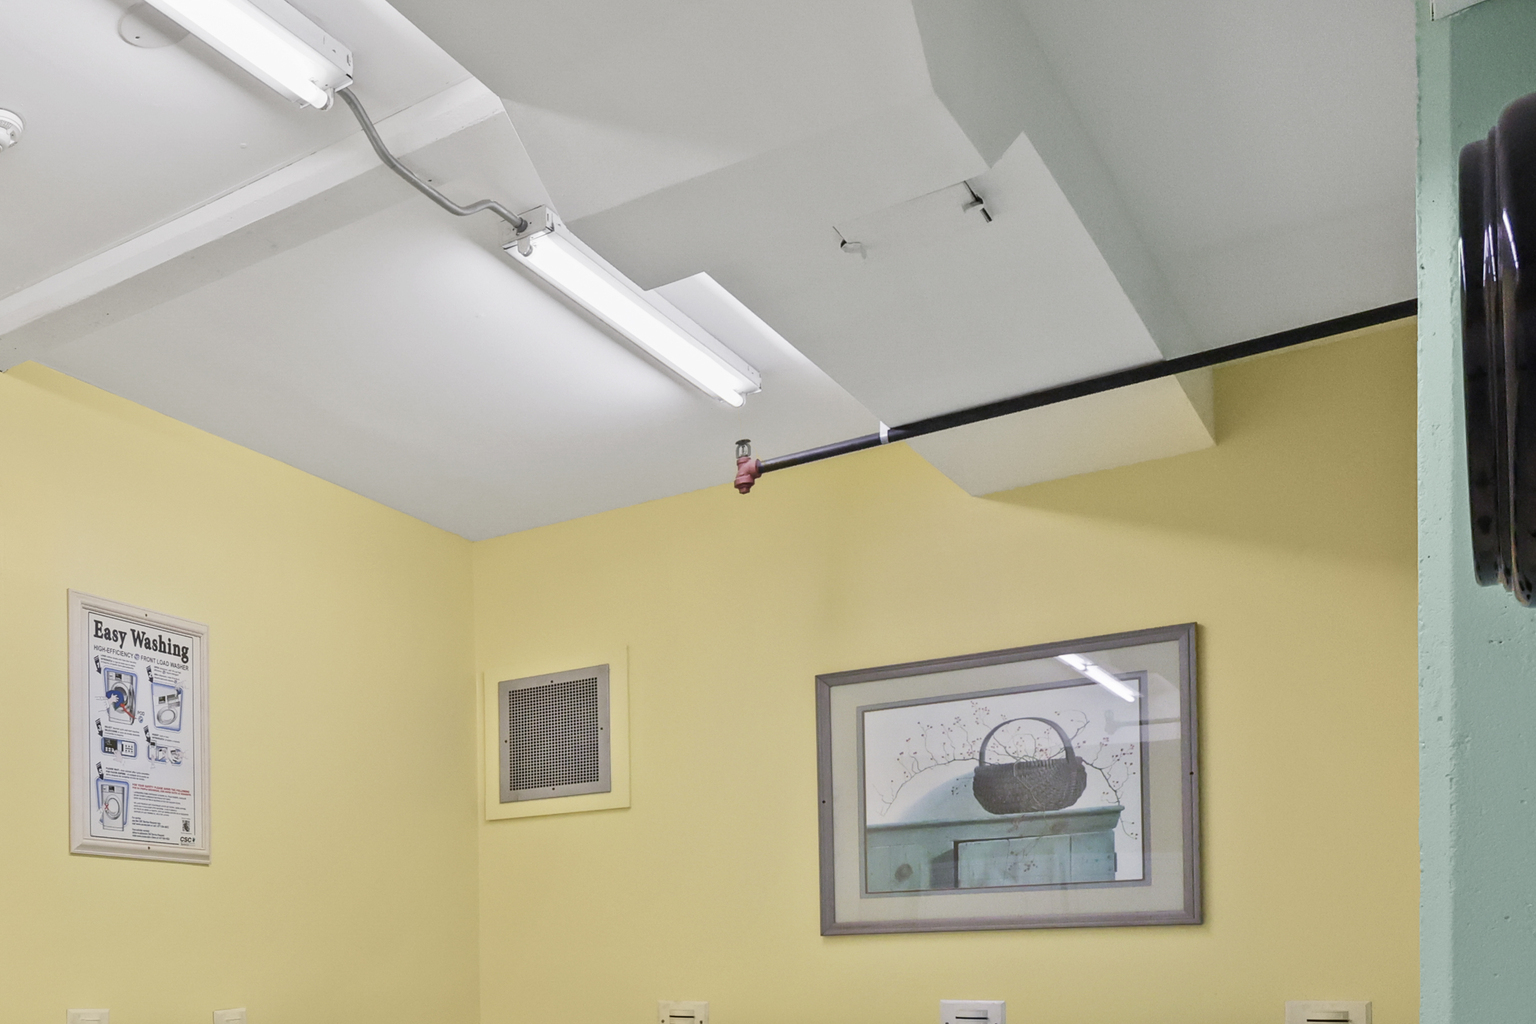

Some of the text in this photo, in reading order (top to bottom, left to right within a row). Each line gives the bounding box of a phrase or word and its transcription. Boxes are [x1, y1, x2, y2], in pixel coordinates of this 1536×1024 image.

[93, 619, 127, 649] Easy
[130, 628, 189, 664] Washing
[93, 645, 134, 659] HIGH-EFFICIENCY
[140, 655, 156, 664] FRONT
[156, 659, 169, 667] LOAD
[170, 662, 189, 671] WASHER
